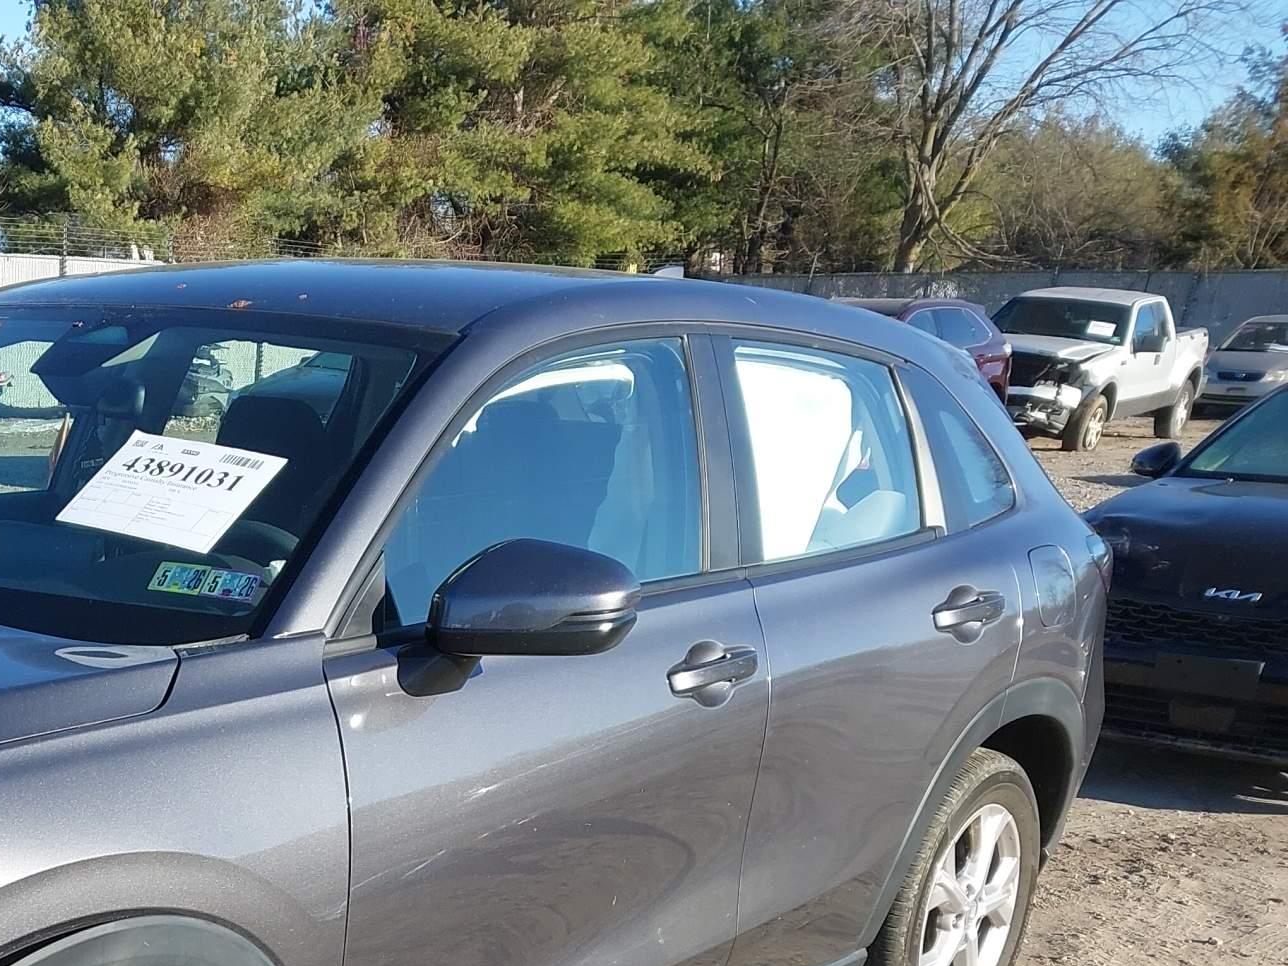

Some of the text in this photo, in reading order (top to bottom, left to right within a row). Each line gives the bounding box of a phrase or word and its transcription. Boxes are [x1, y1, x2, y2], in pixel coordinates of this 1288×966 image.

[122, 455, 244, 491] 43891031
[157, 570, 171, 587] 5
[208, 576, 221, 593] 5
